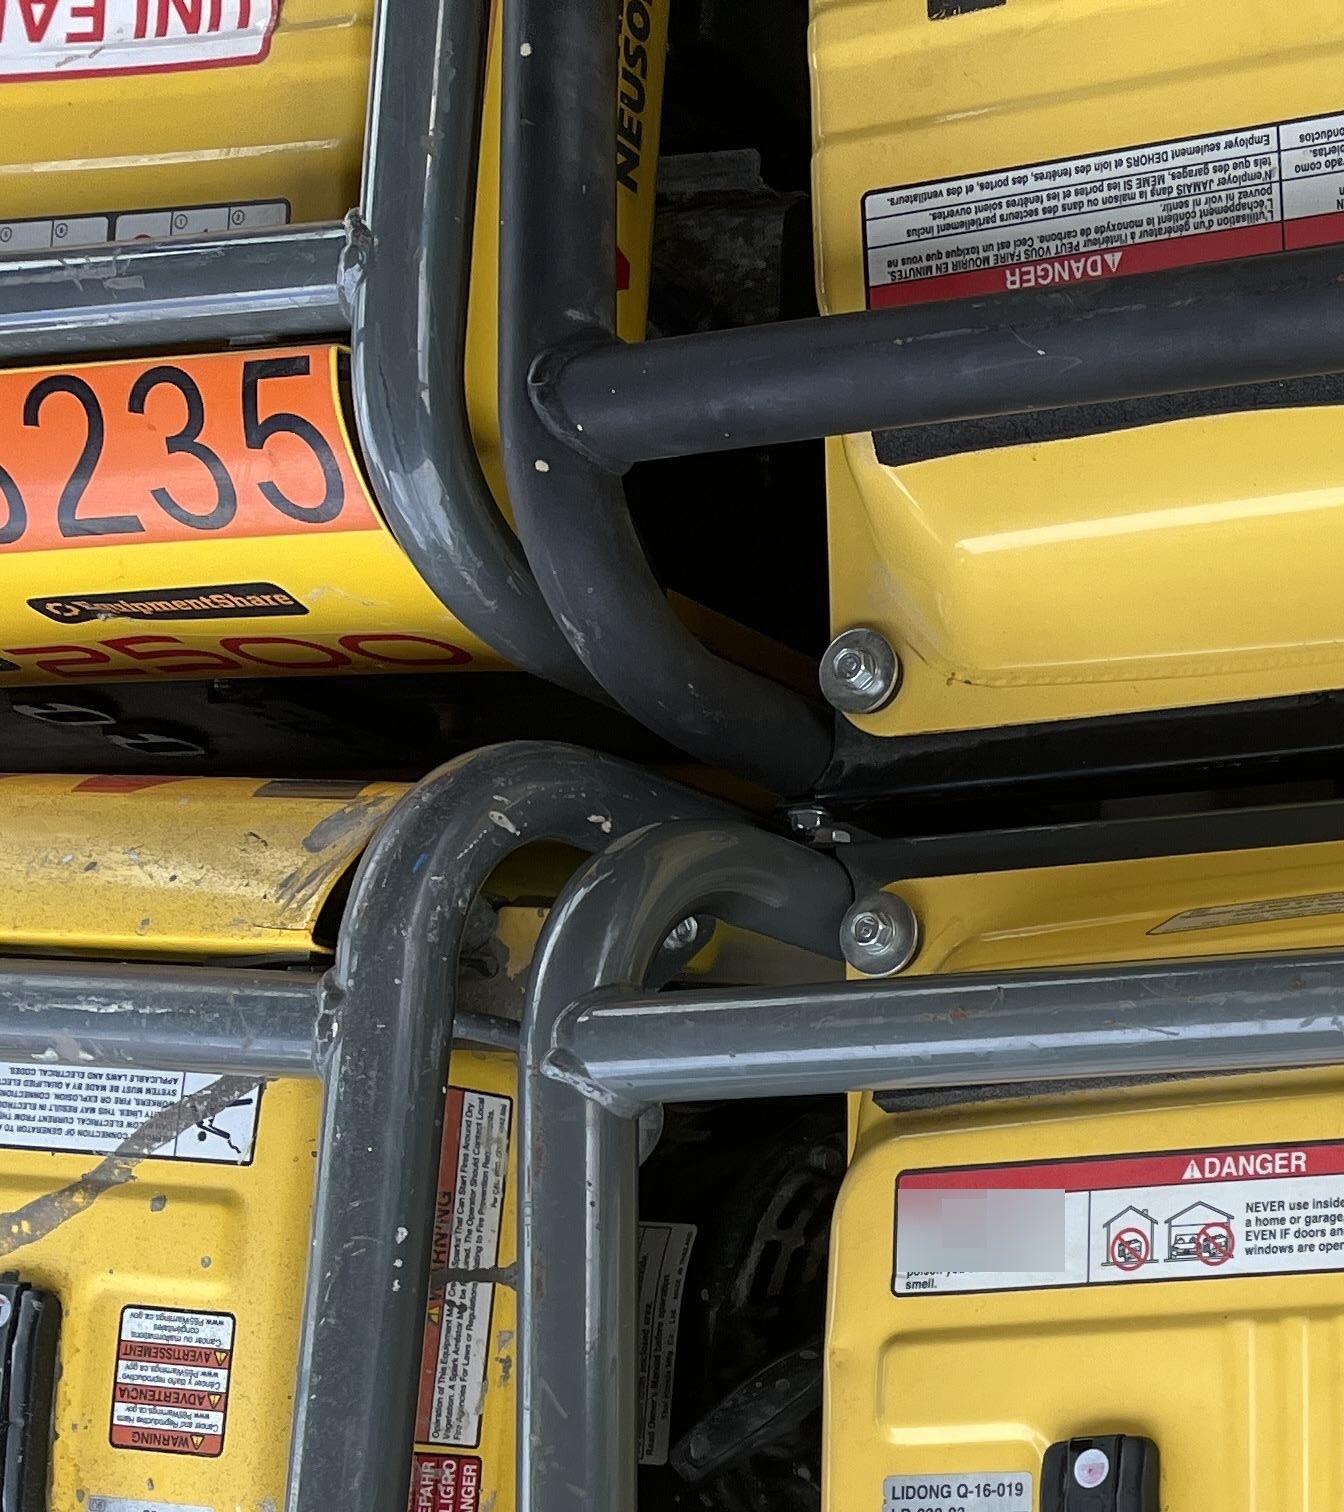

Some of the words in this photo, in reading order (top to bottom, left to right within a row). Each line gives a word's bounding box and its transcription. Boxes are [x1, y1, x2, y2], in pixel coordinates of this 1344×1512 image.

[616, 0, 650, 193] NEUSO
[1004, 254, 1102, 289] DANGER
[0, 633, 473, 678] 2500
[1203, 1151, 1306, 1178] DANGER
[1245, 1199, 1285, 1213] NEVER
[1288, 1200, 1309, 1211] use
[1244, 1217, 1252, 1228] a
[1254, 1215, 1286, 1227] home
[1288, 1215, 1302, 1225] or
[1244, 1228, 1276, 1242] EVEN
[1279, 1227, 1291, 1239] IF
[1292, 1226, 1326, 1239] doors
[1244, 1242, 1294, 1256] windows
[1296, 1242, 1315, 1253] are
[905, 1277, 937, 1290] smell.
[122, 1344, 210, 1363] AVERTISSEMENT
[118, 1386, 205, 1406] ADVERTENCIA
[131, 1431, 190, 1448] WARNING
[891, 1484, 951, 1500] LIDONG
[956, 1482, 1023, 1498] Q-16-019
